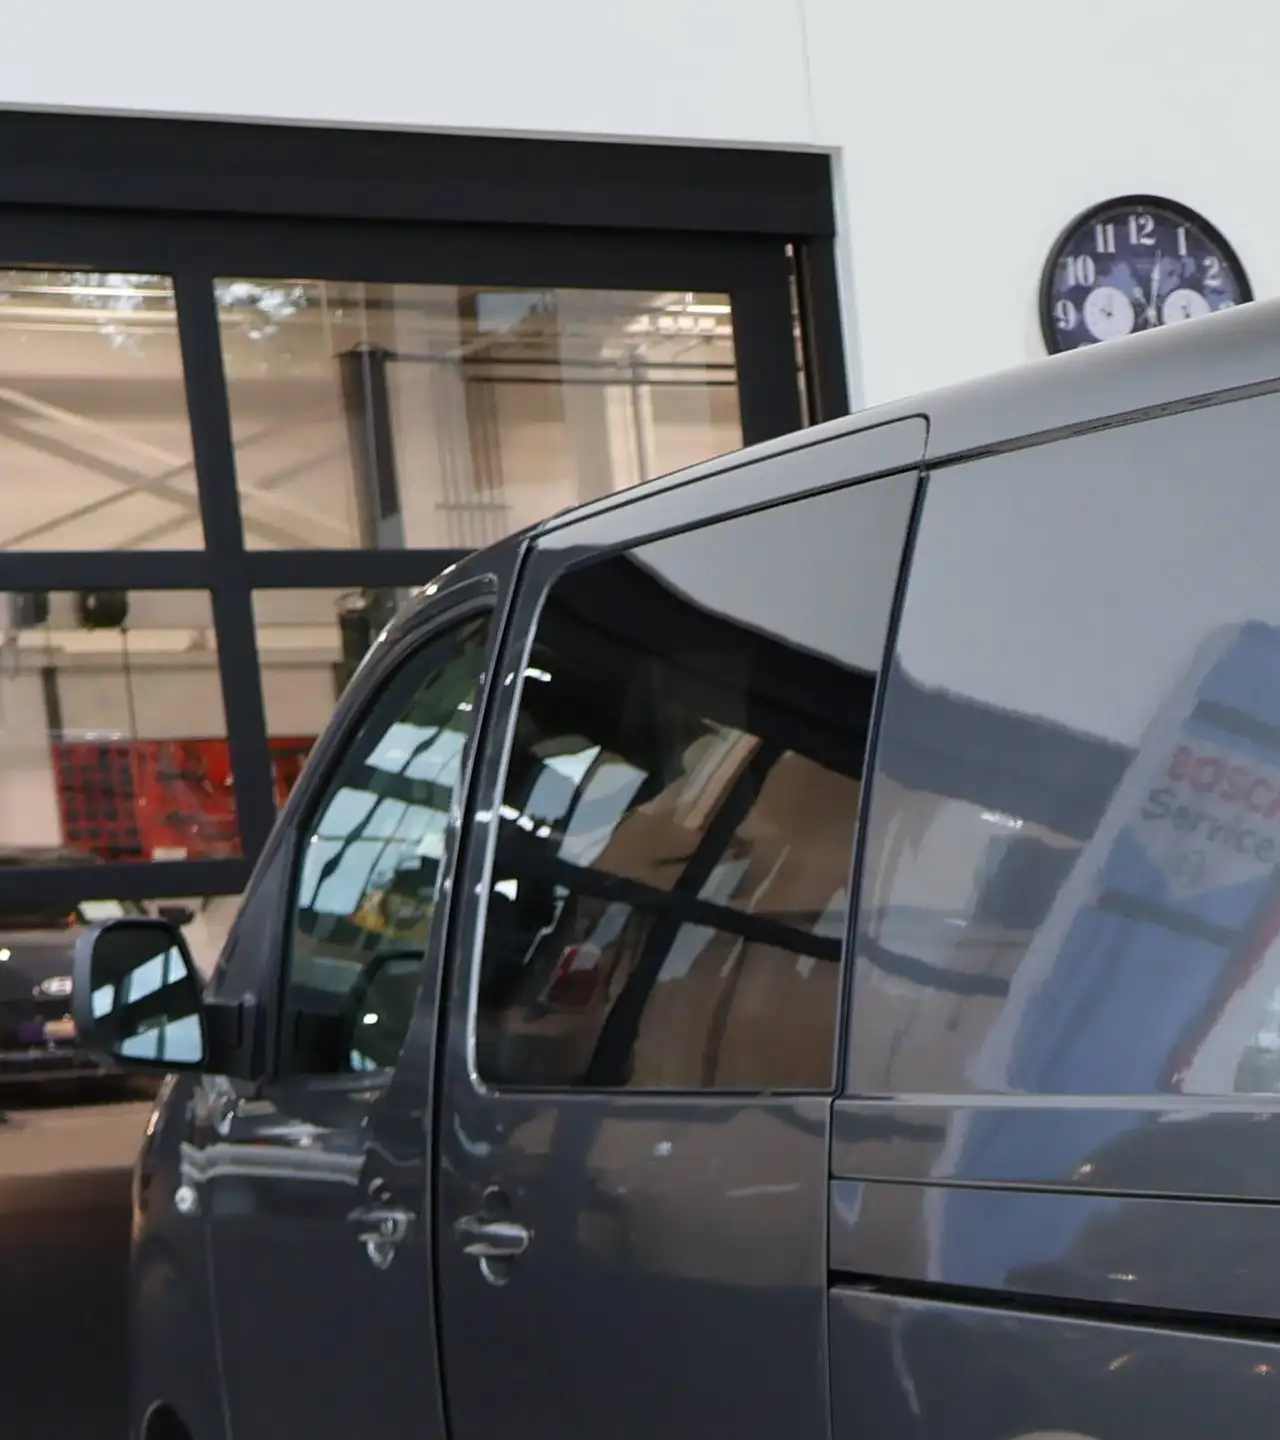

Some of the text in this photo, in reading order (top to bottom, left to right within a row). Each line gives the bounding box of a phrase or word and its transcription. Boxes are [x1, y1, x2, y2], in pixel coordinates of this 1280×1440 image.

[1095, 223, 1116, 253] 11
[1127, 214, 1157, 245] 12
[1177, 226, 1188, 256] 1
[1064, 254, 1096, 287] 10
[1203, 255, 1222, 287] 2
[1054, 299, 1077, 331] 9
[1141, 786, 1276, 864] Service
